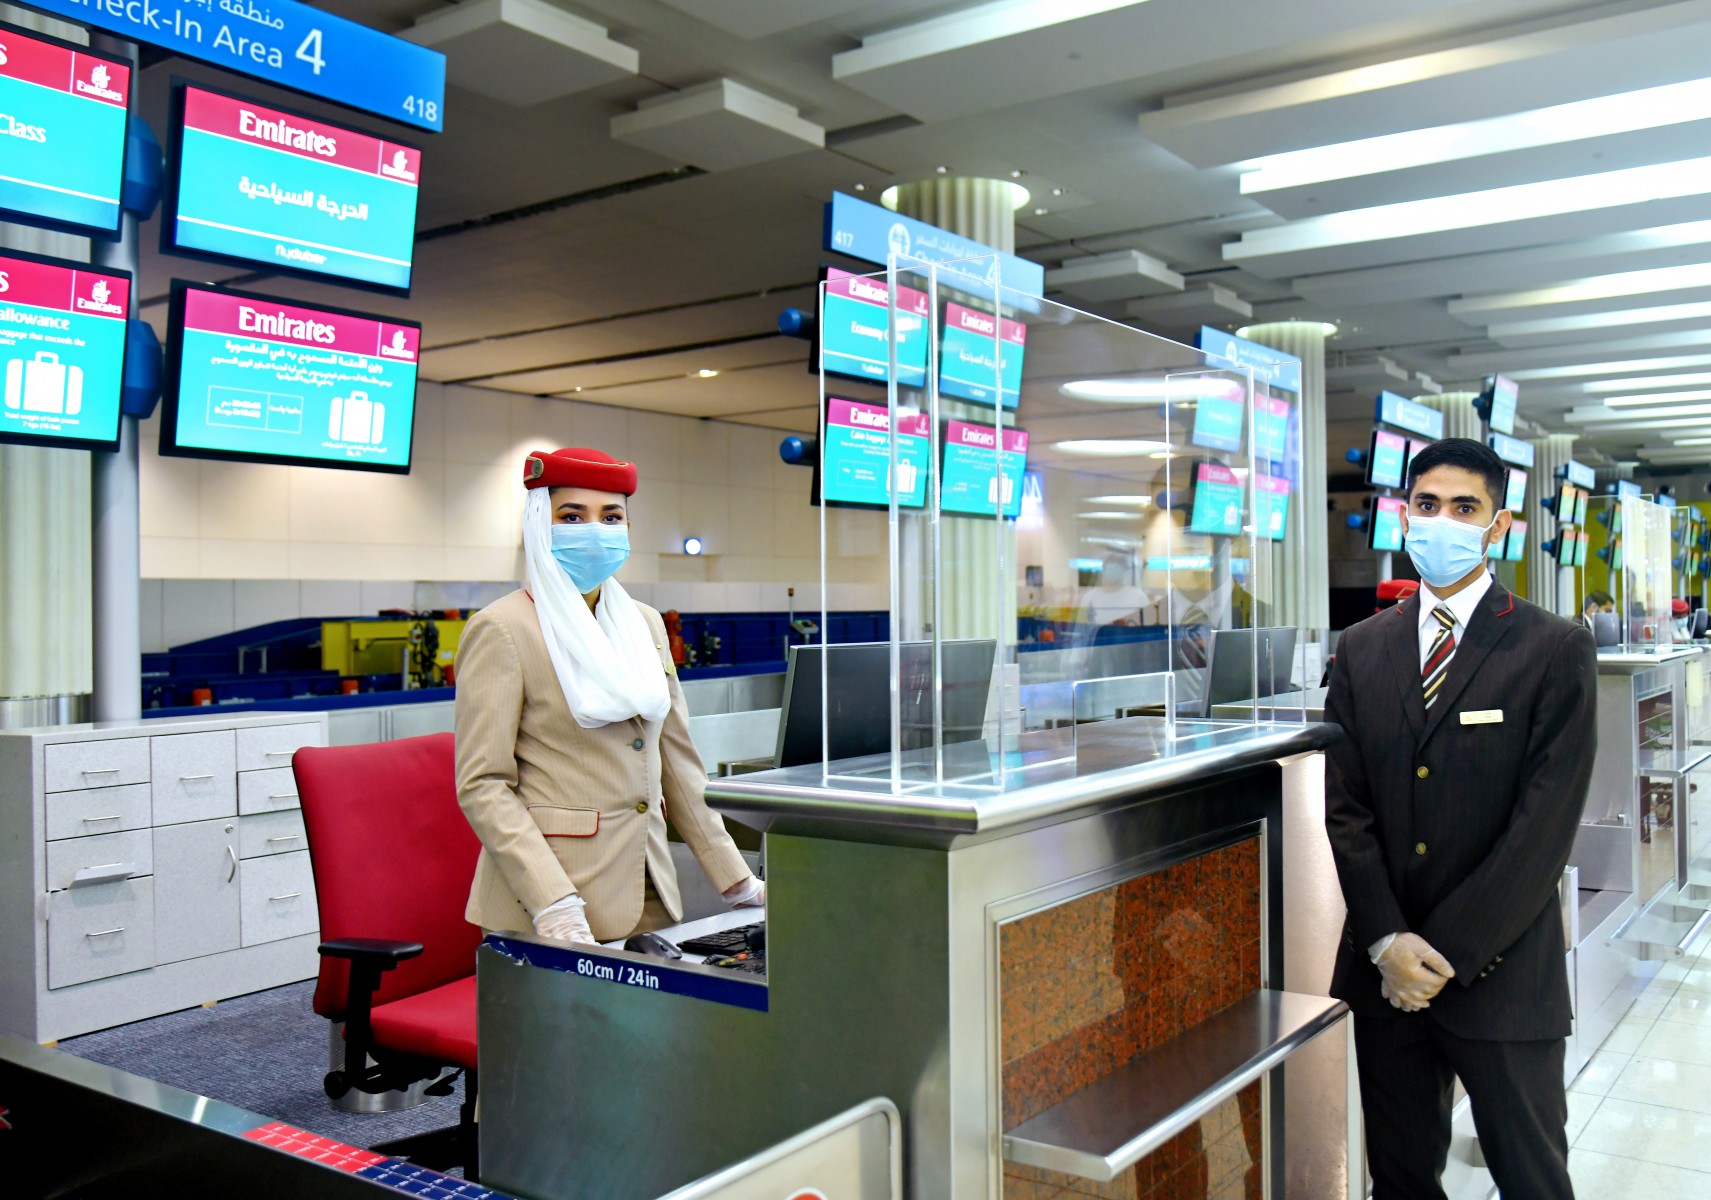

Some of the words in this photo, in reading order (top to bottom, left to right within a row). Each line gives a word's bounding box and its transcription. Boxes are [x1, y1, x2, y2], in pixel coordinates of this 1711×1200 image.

[69, 0, 202, 43] eck-In
[213, 25, 283, 69] Area
[295, 28, 326, 76] 4
[76, 80, 123, 102] Emirates
[402, 95, 438, 122] 418
[0, 113, 47, 144] Class
[239, 110, 337, 158] Emirates
[238, 175, 314, 208] السياحية
[316, 194, 369, 220] الدرجة
[834, 229, 855, 249] 417
[849, 279, 889, 305] Emirate
[77, 296, 123, 315] Emirates
[239, 305, 336, 344] Emirates
[850, 406, 889, 430] Emirate
[962, 427, 995, 447] Emirates
[577, 958, 614, 980] 60cm
[627, 967, 659, 989] 24in
